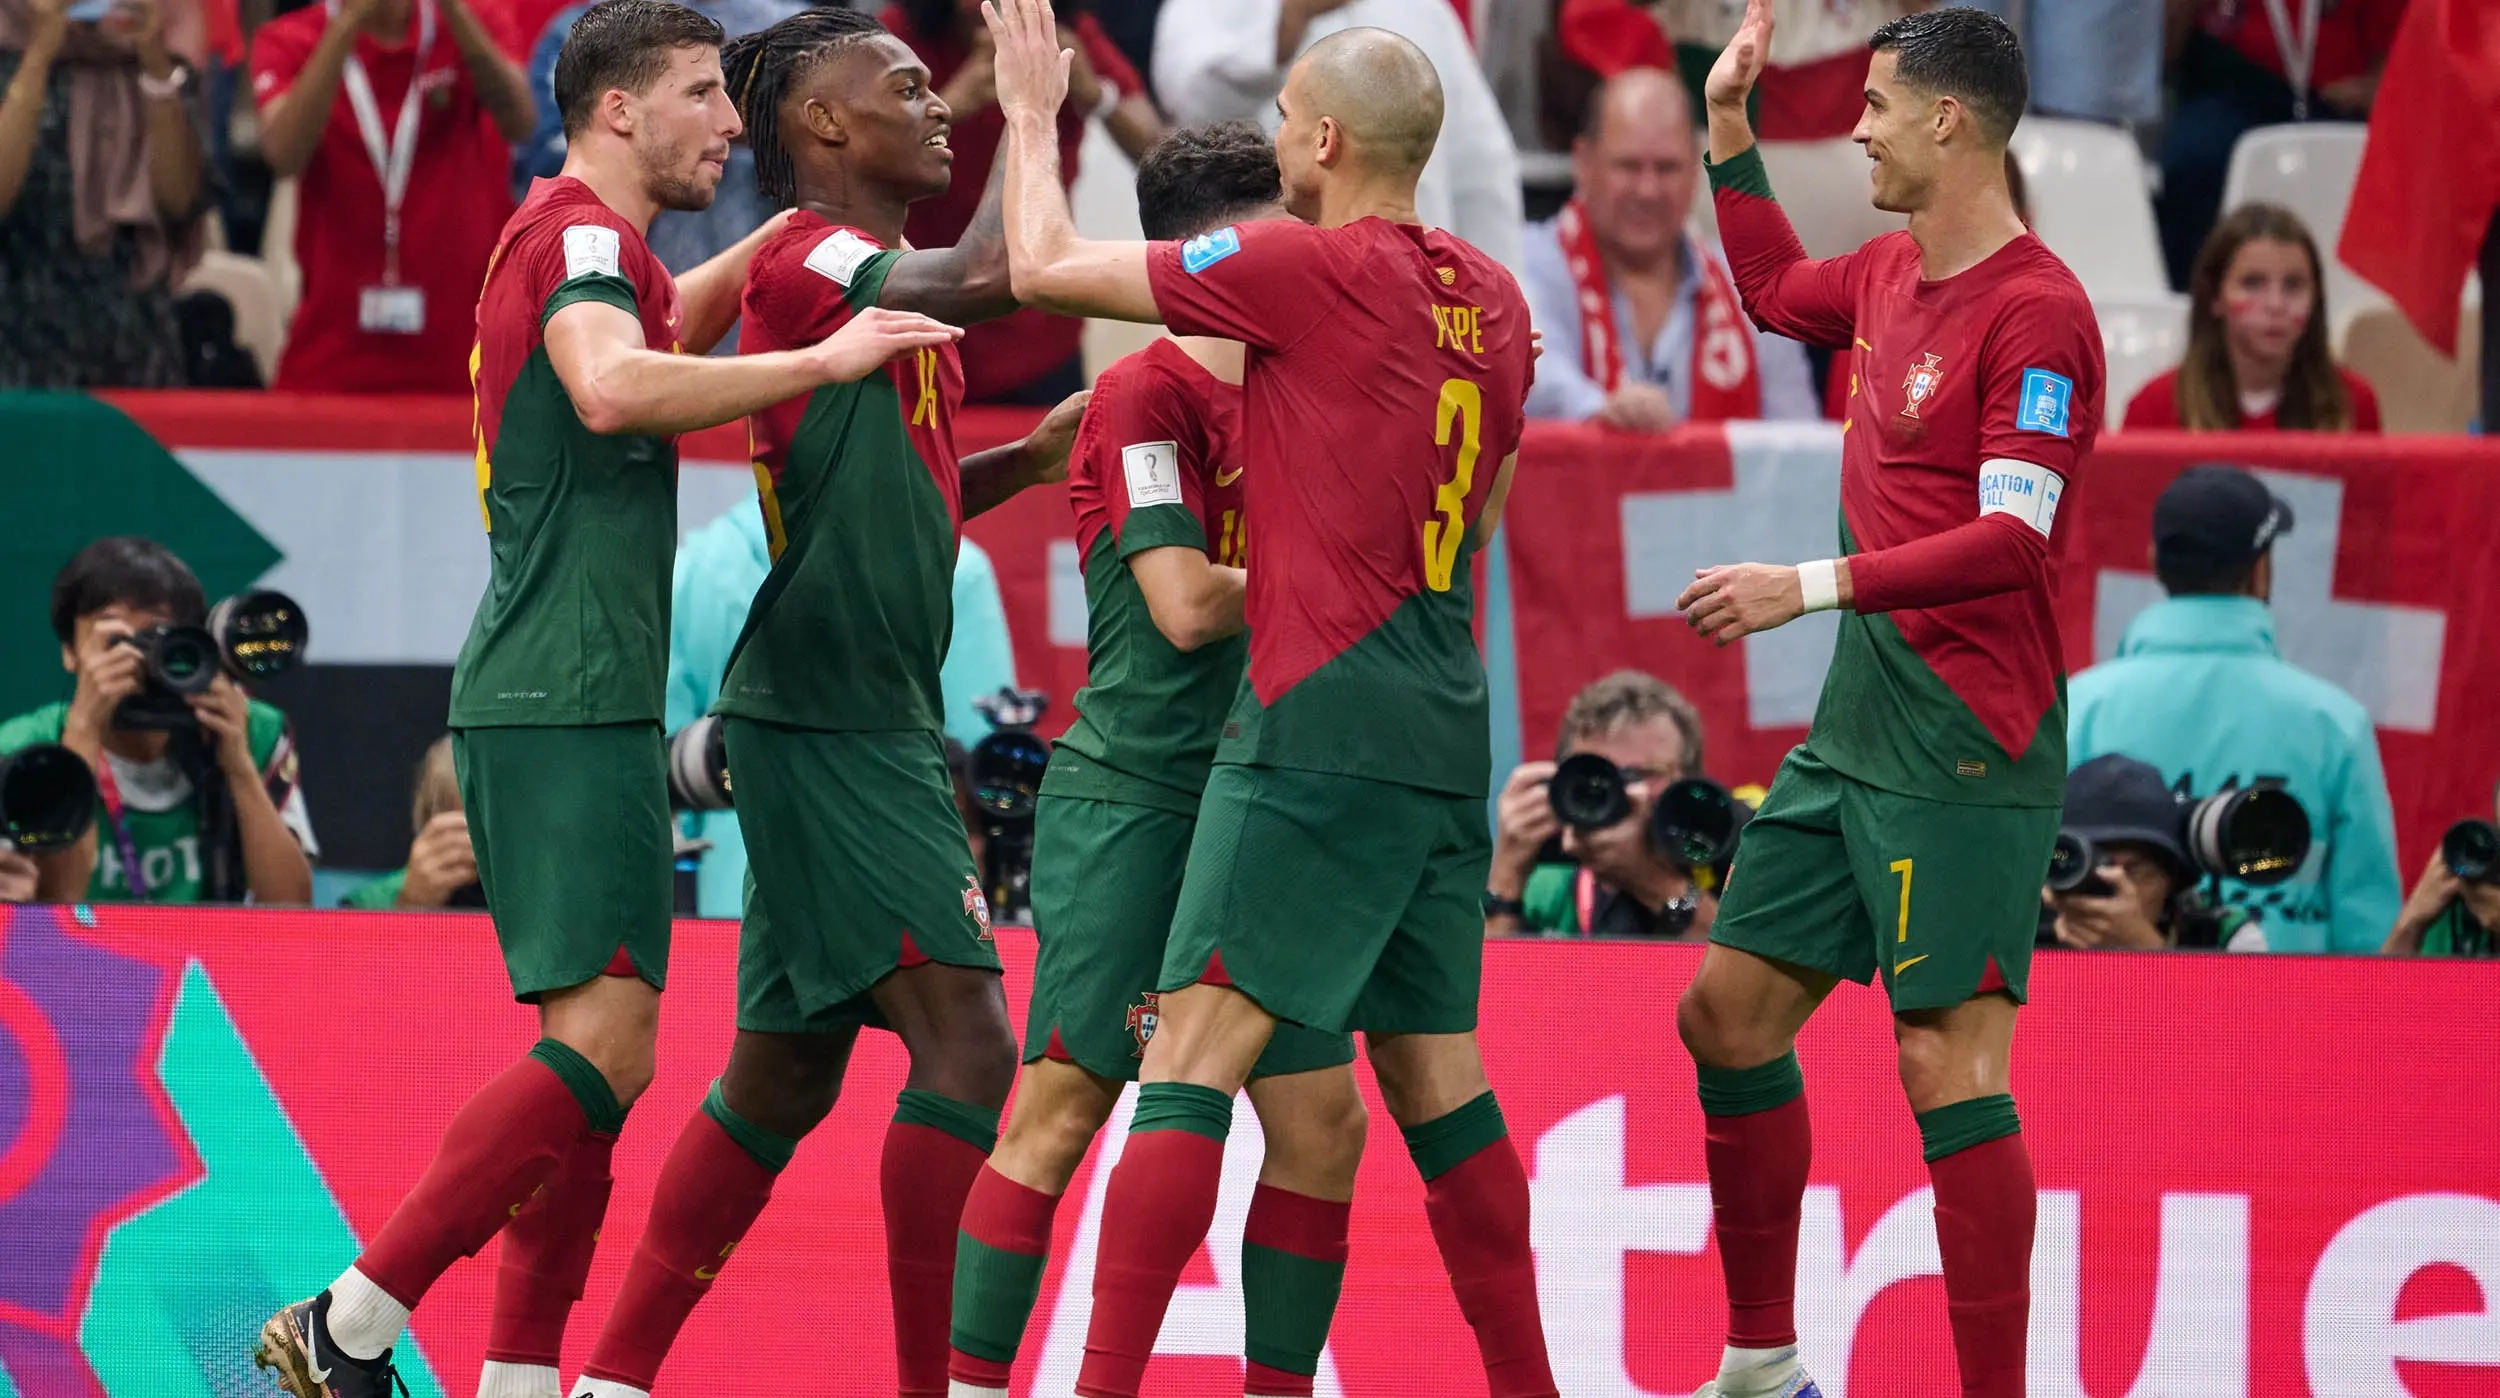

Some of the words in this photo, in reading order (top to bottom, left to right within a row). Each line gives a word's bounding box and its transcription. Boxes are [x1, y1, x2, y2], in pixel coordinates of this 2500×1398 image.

[1431, 303, 1485, 354] PEPE
[1423, 378, 1482, 592] 3
[1980, 473, 2034, 497] UCATION
[100, 835, 201, 889] HOT
[1889, 858, 1913, 944] 7
[1025, 1080, 1346, 1398] A
[1527, 1093, 2500, 1398] true
